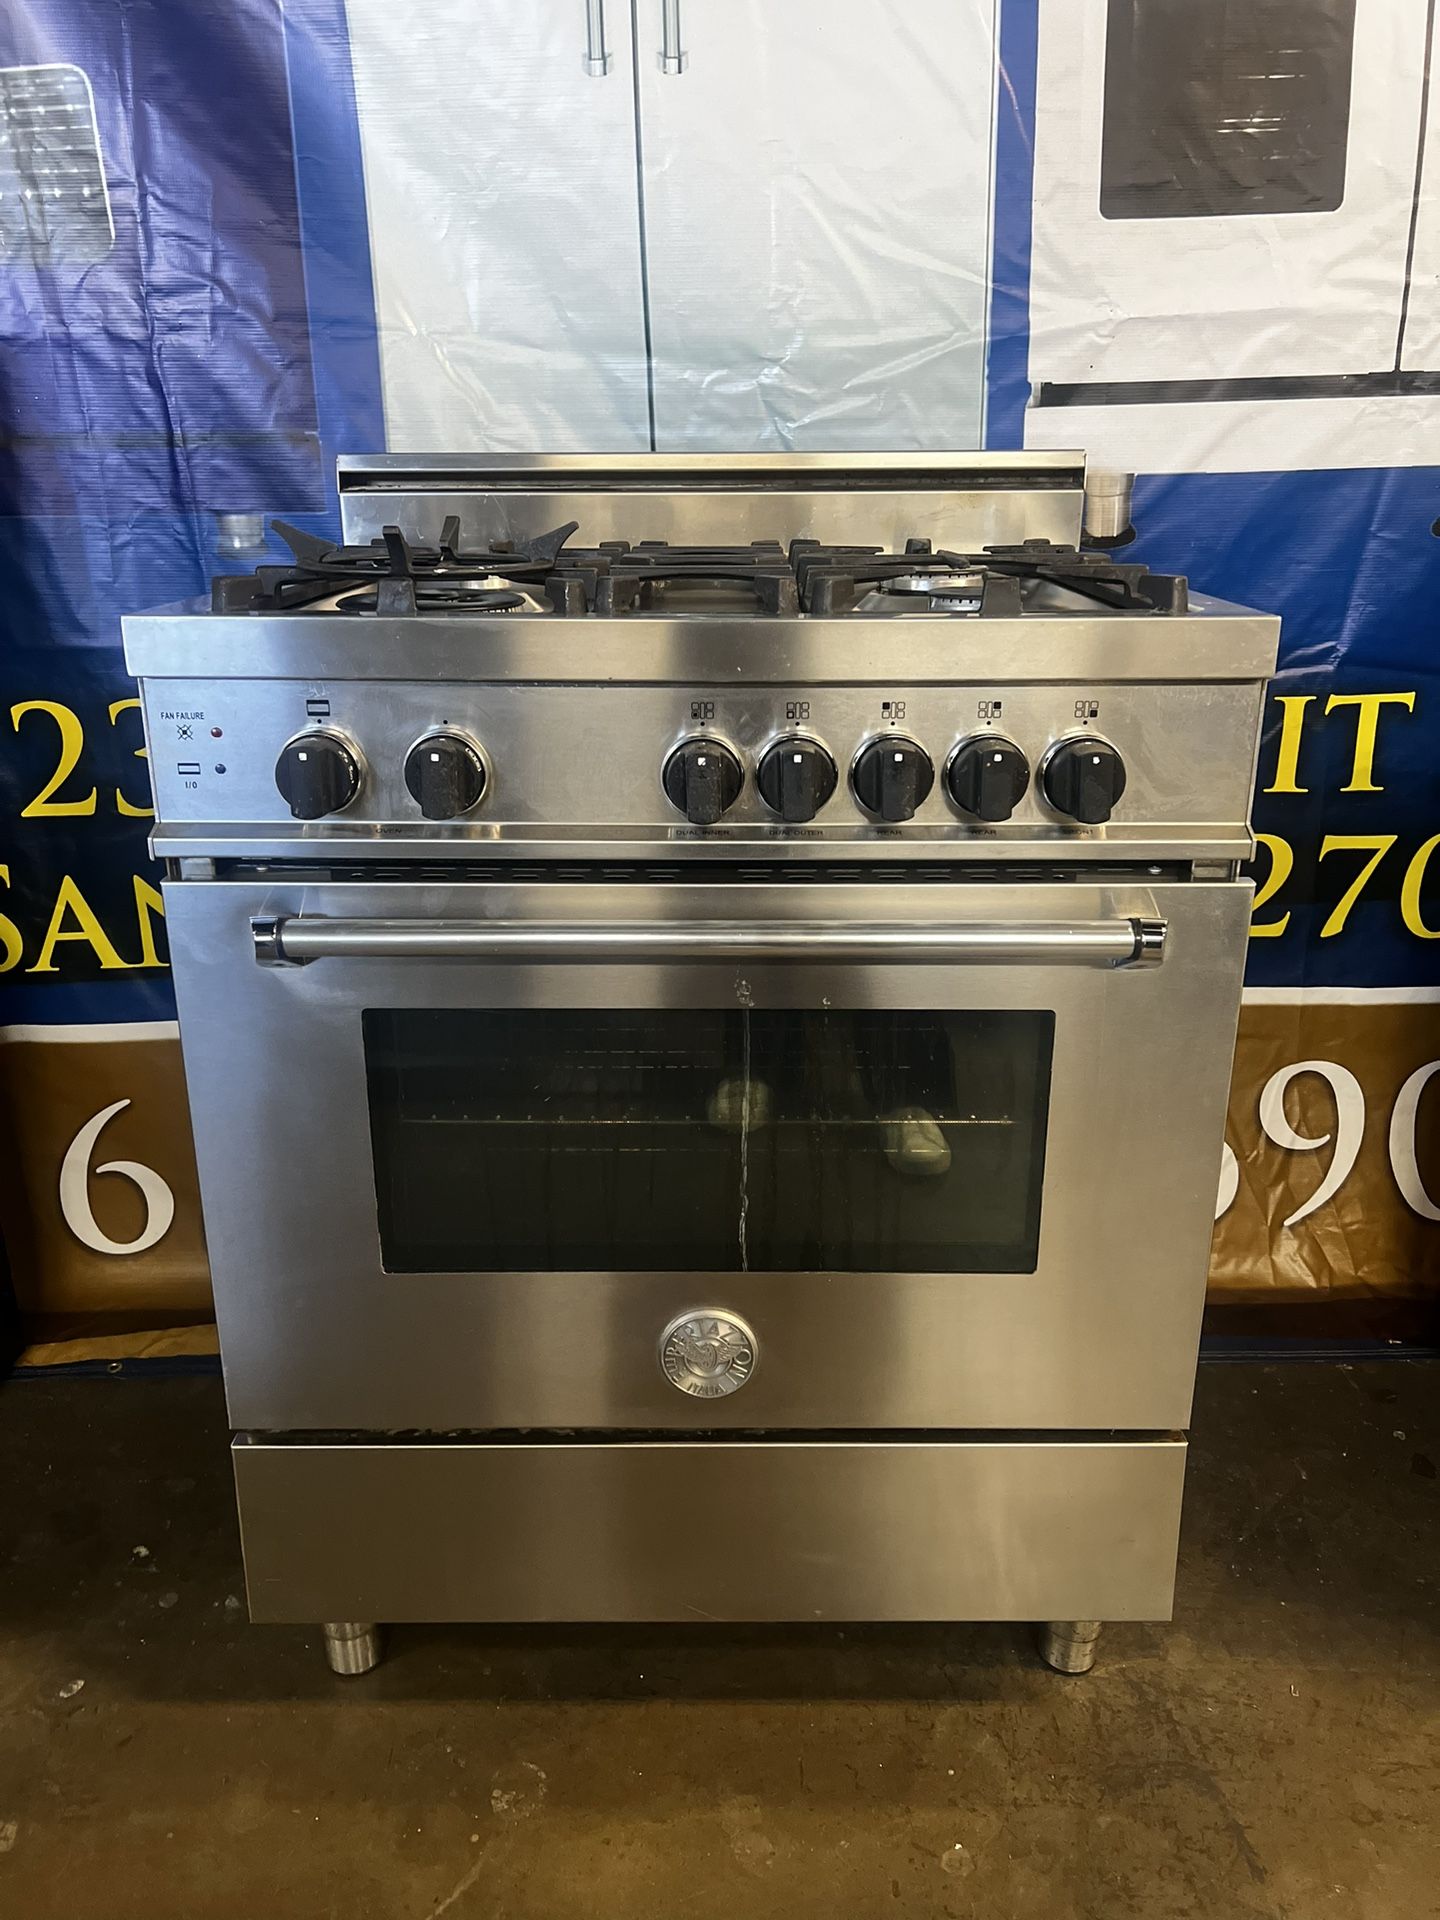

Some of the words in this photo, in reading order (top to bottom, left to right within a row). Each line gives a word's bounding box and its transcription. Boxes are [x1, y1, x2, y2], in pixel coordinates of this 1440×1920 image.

[160, 711, 175, 720] FAN
[176, 711, 205, 720] FAILURE
[60, 1098, 174, 1254] 6
